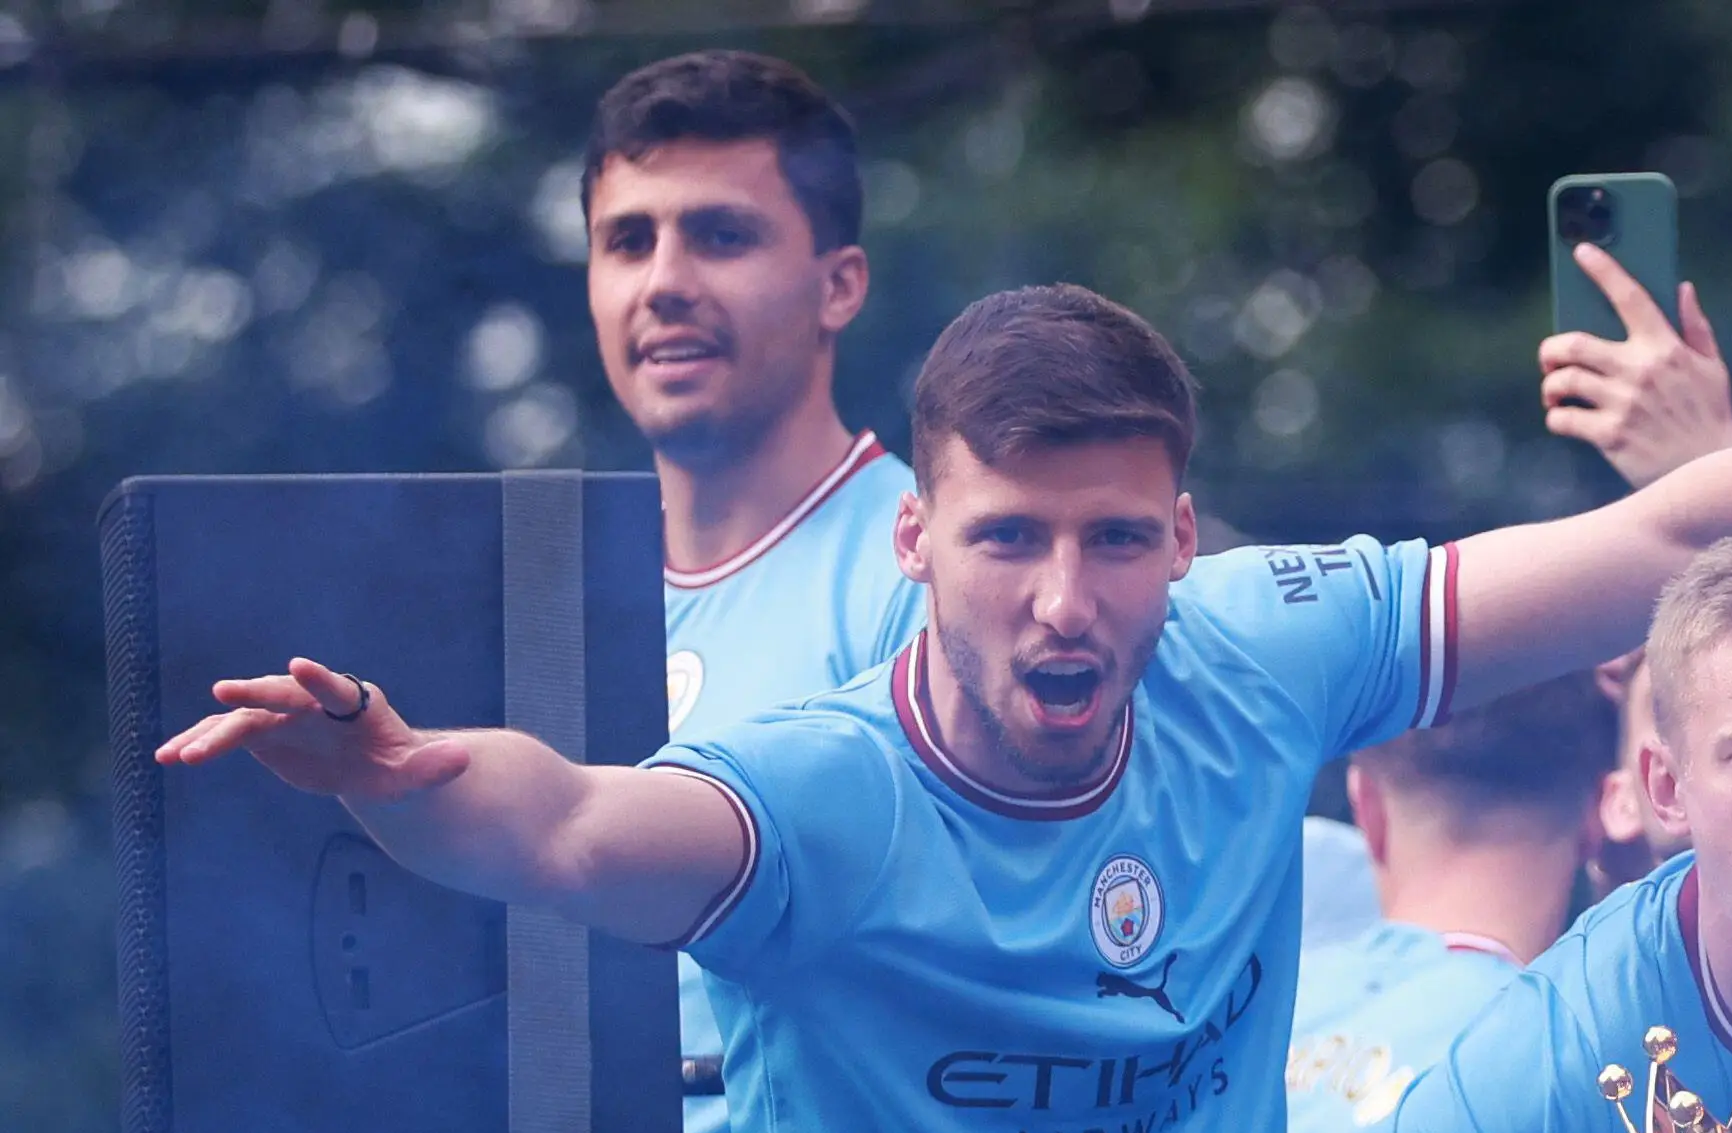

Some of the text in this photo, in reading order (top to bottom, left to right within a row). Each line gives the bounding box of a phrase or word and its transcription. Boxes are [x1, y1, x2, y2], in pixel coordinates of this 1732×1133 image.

[1094, 862, 1151, 908] MANCHESTER
[1120, 944, 1142, 961] CITY
[926, 952, 1262, 1110] ETIHAD
